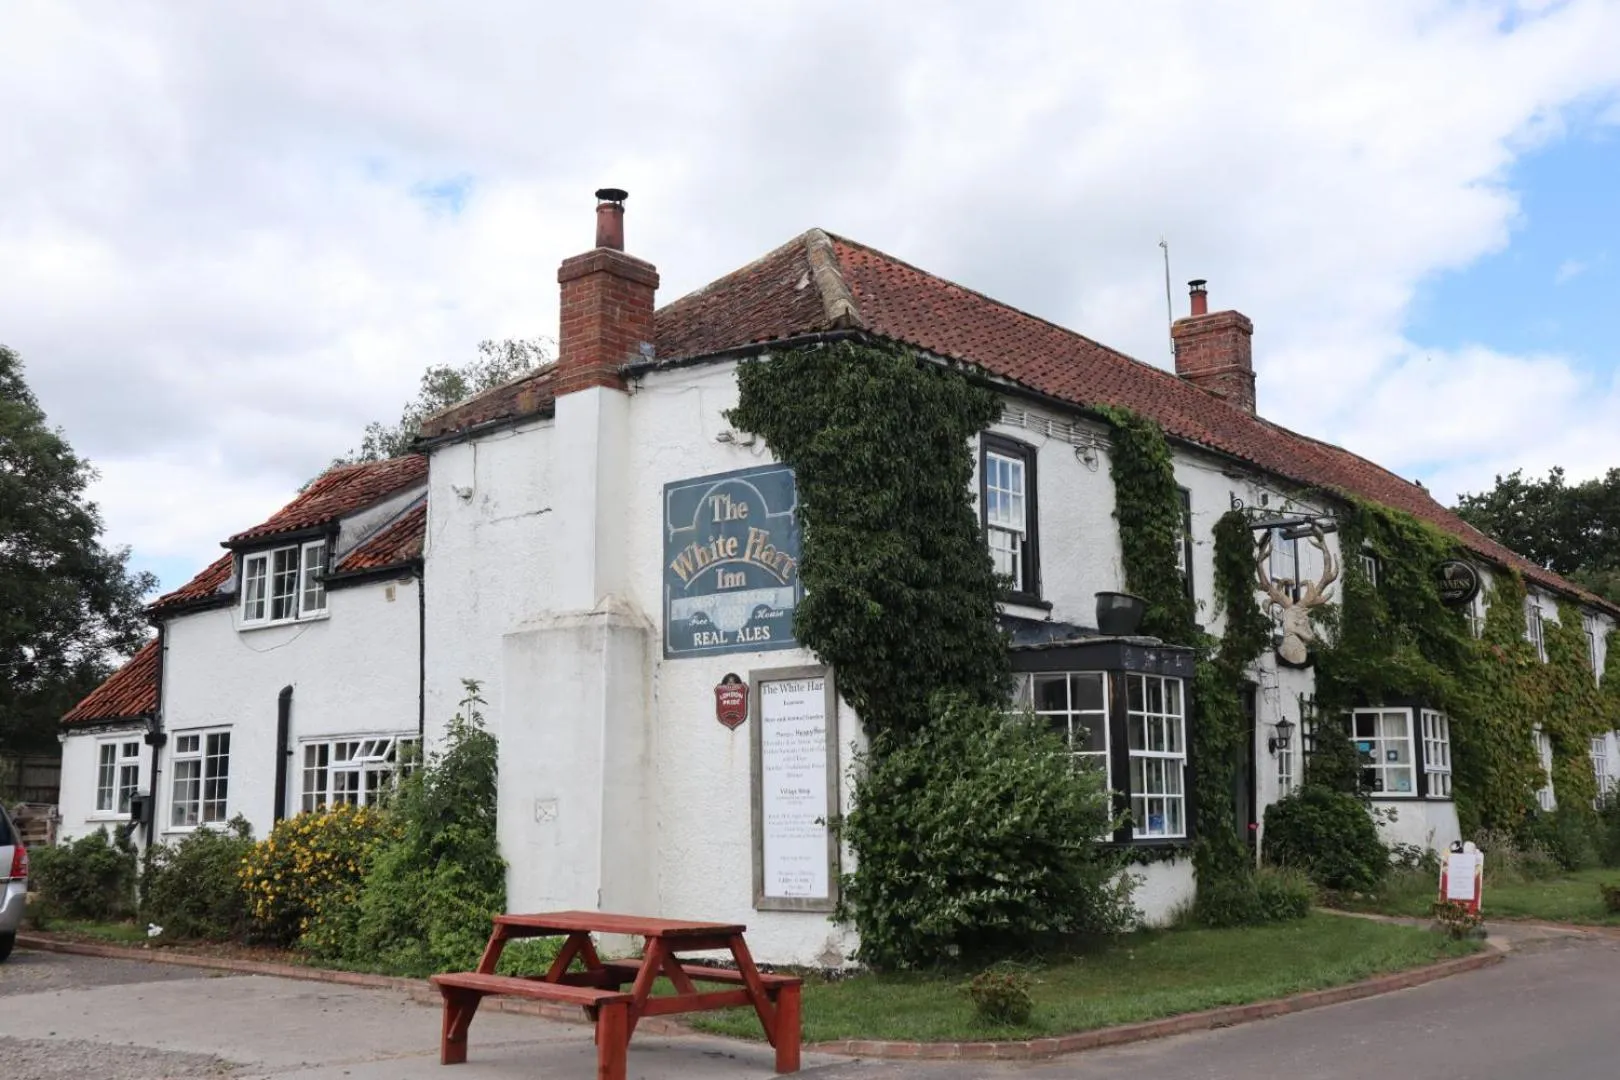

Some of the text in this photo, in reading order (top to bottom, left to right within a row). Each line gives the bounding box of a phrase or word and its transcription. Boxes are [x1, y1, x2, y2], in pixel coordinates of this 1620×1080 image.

[708, 493, 749, 522] The
[670, 527, 797, 581] White Hart
[715, 568, 746, 589] Inn
[693, 625, 771, 646] REAL ALES
[762, 680, 824, 694] The White Har
